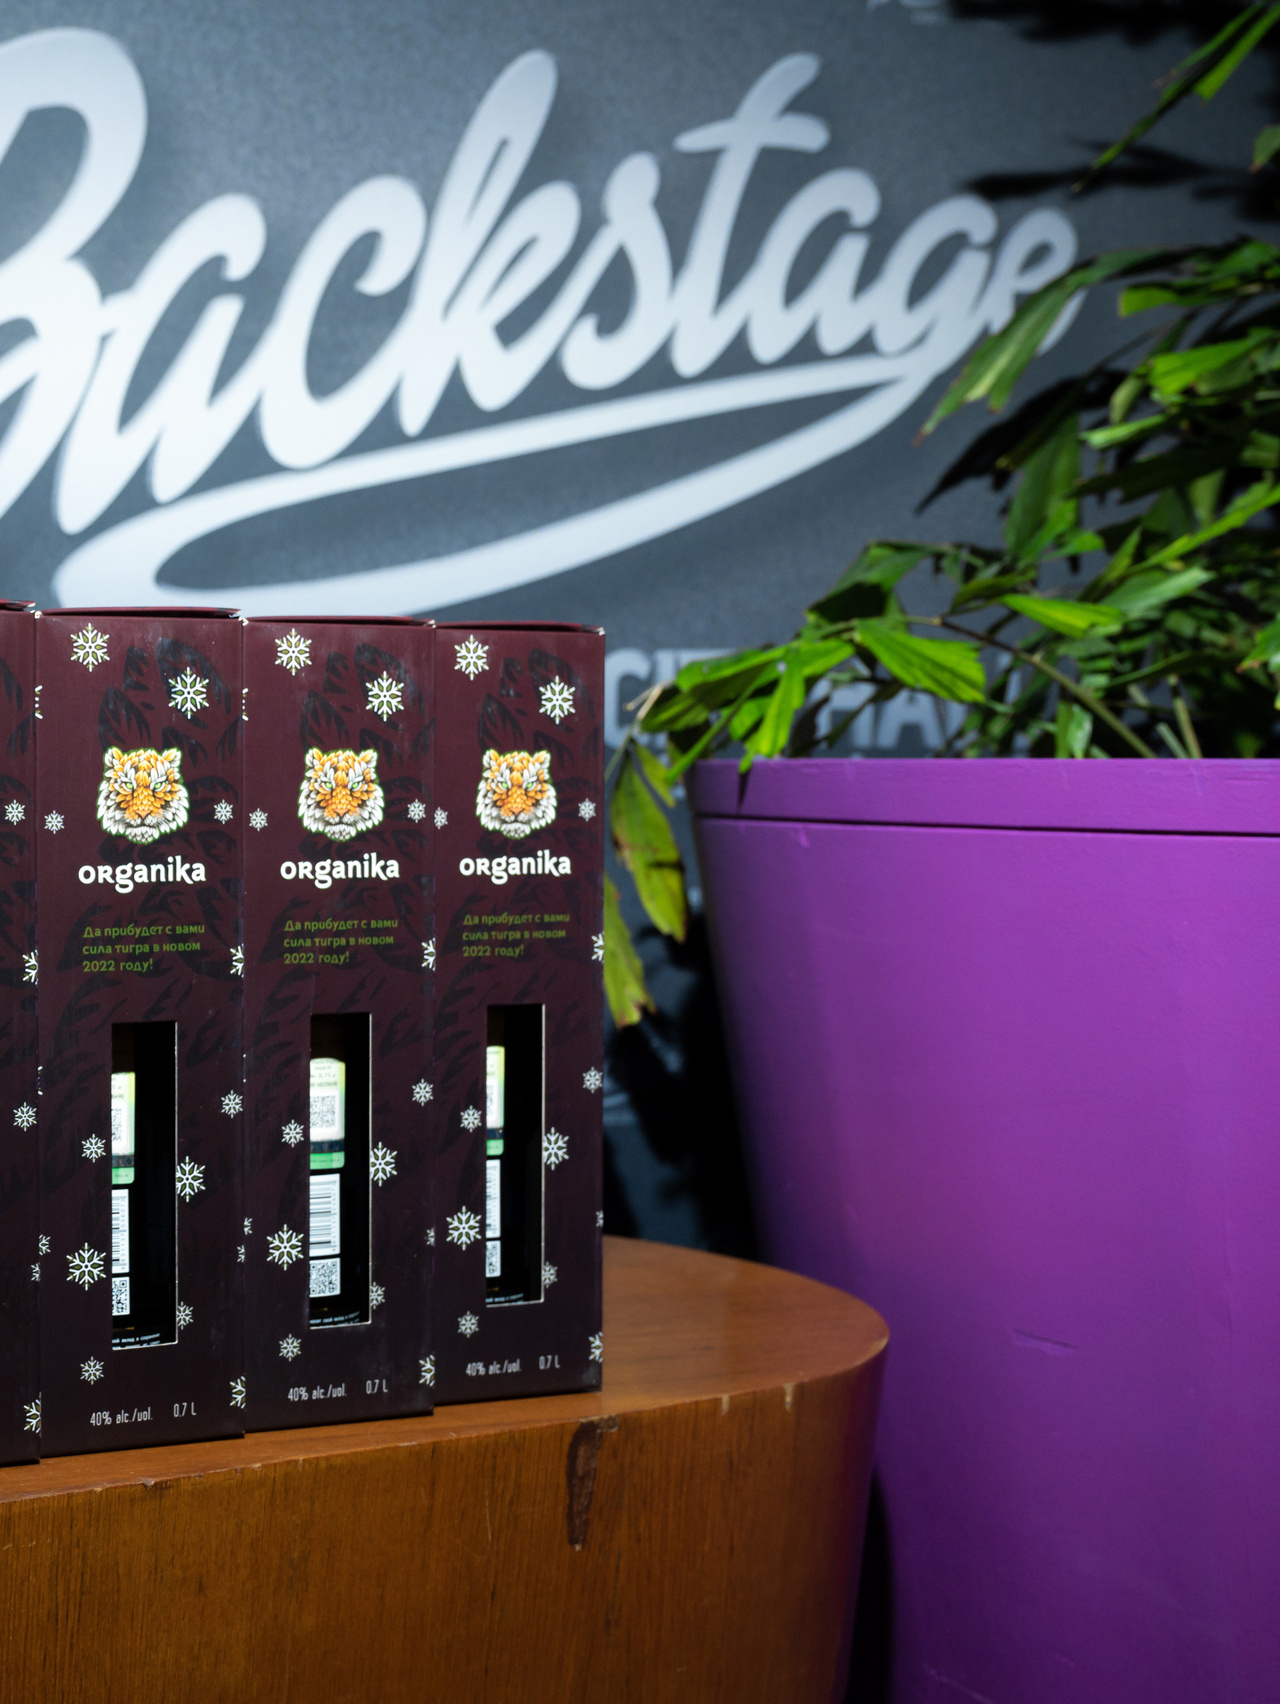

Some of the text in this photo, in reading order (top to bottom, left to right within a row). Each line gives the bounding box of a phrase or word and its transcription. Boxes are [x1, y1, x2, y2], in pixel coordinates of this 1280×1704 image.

[82, 923, 205, 939] Да прибудет с вами
[284, 920, 302, 932] Да
[361, 920, 367, 929] с
[370, 919, 398, 928] вами
[82, 942, 201, 956] сила тигра в новом
[283, 936, 394, 948] сила тигра в новом
[82, 958, 153, 972] 2022 году!
[283, 953, 314, 964] 2022
[287, 1386, 309, 1401] 40%
[90, 1411, 112, 1426] 40%
[173, 1402, 187, 1418] 0.7
